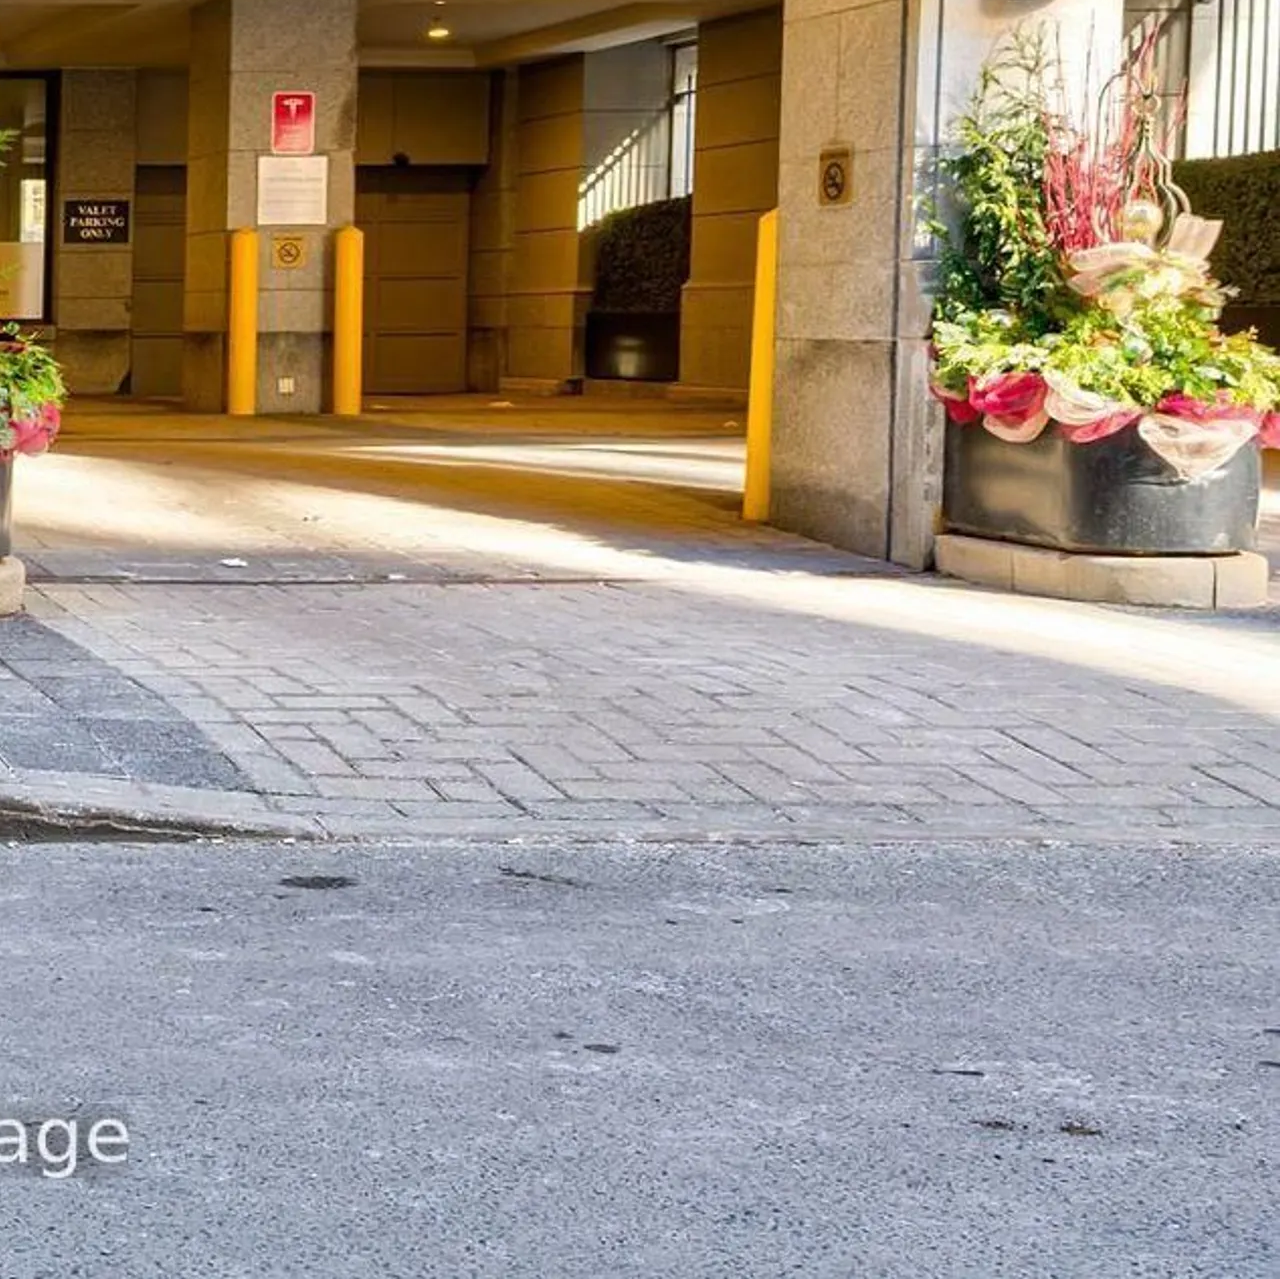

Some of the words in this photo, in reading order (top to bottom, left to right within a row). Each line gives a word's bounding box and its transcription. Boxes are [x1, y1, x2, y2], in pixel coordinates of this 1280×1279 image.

[78, 205, 117, 215] VALET
[69, 217, 125, 227] PARKING
[80, 228, 114, 239] ONLY
